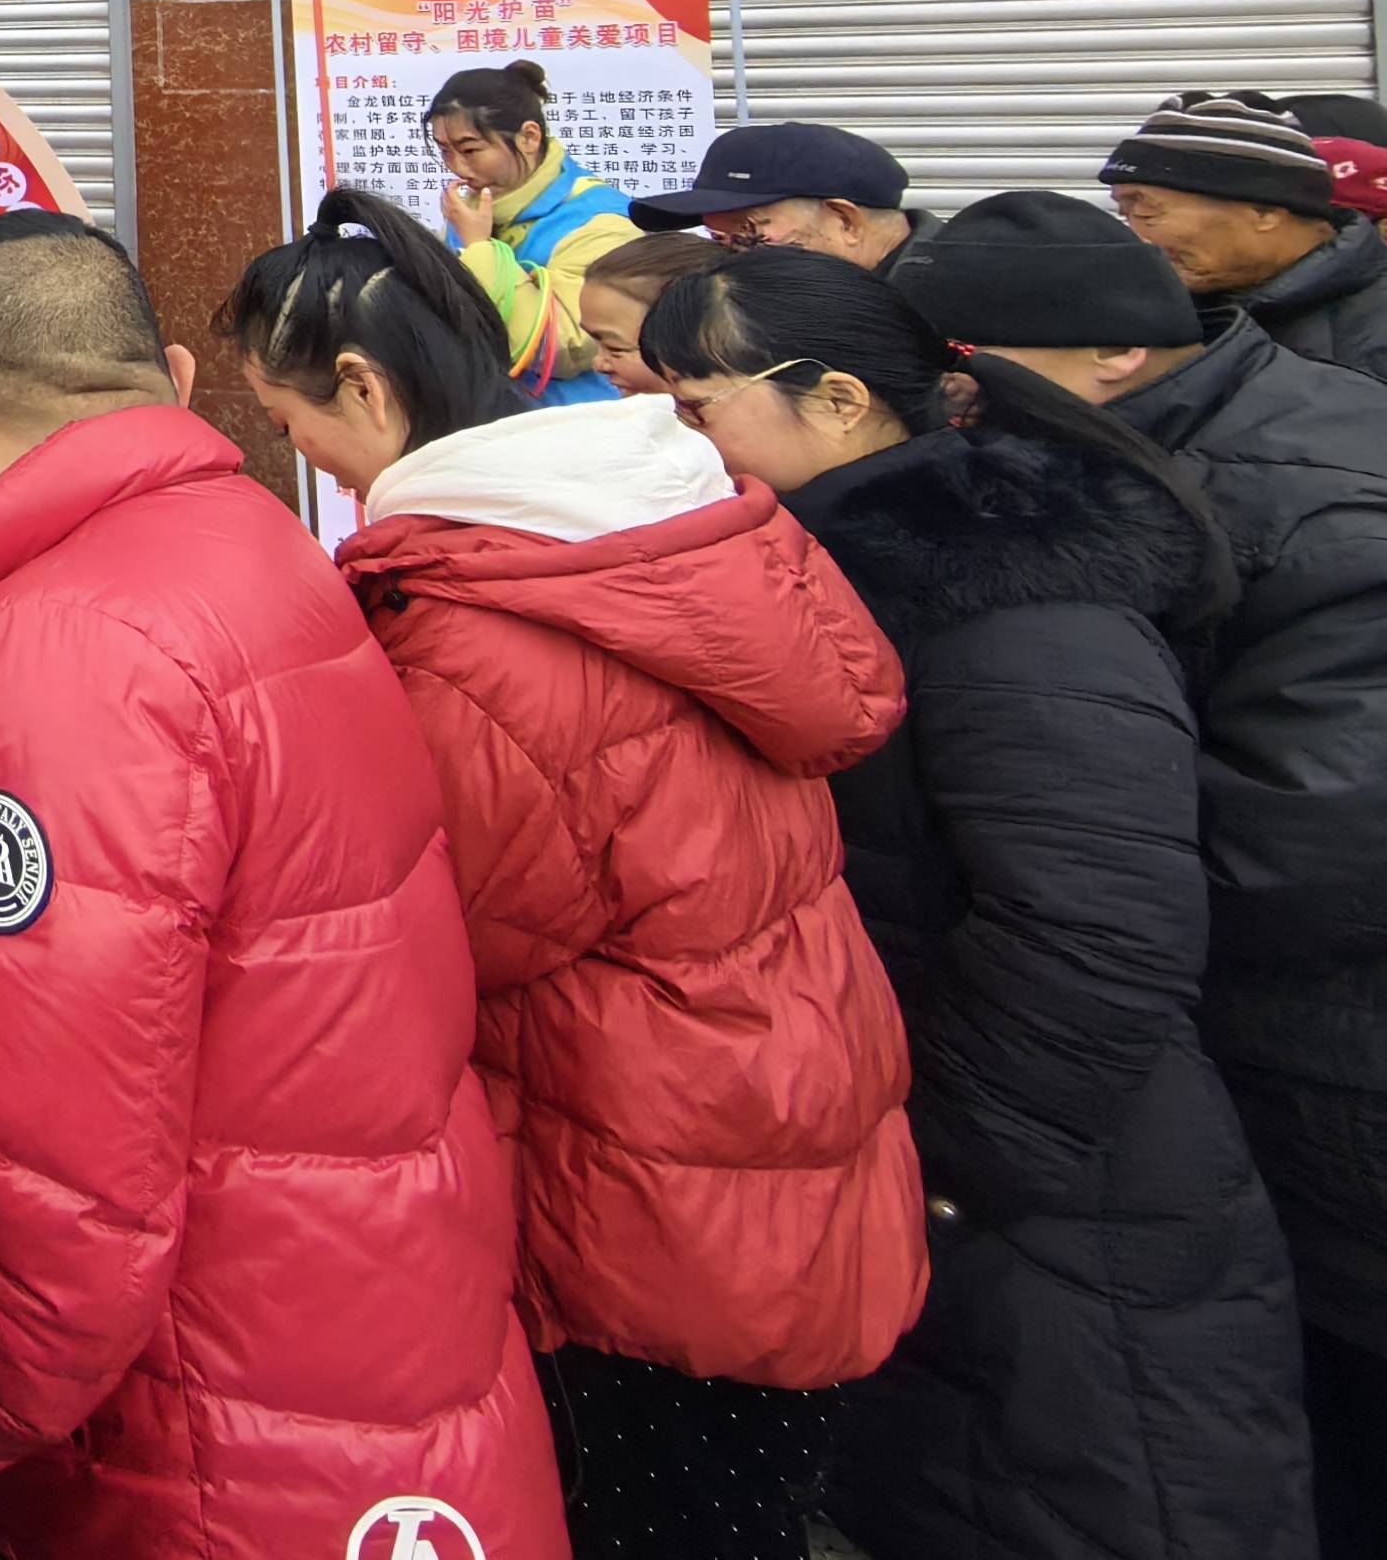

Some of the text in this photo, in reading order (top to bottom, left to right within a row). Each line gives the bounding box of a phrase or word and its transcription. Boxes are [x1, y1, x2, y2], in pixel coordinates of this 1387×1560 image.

[326, 22, 679, 56] 农村留守、困境儿童关爱项目
[347, 89, 693, 107] 金龙镇位于 由于当地经济条件
[16, 836, 40, 906] SENIOR
